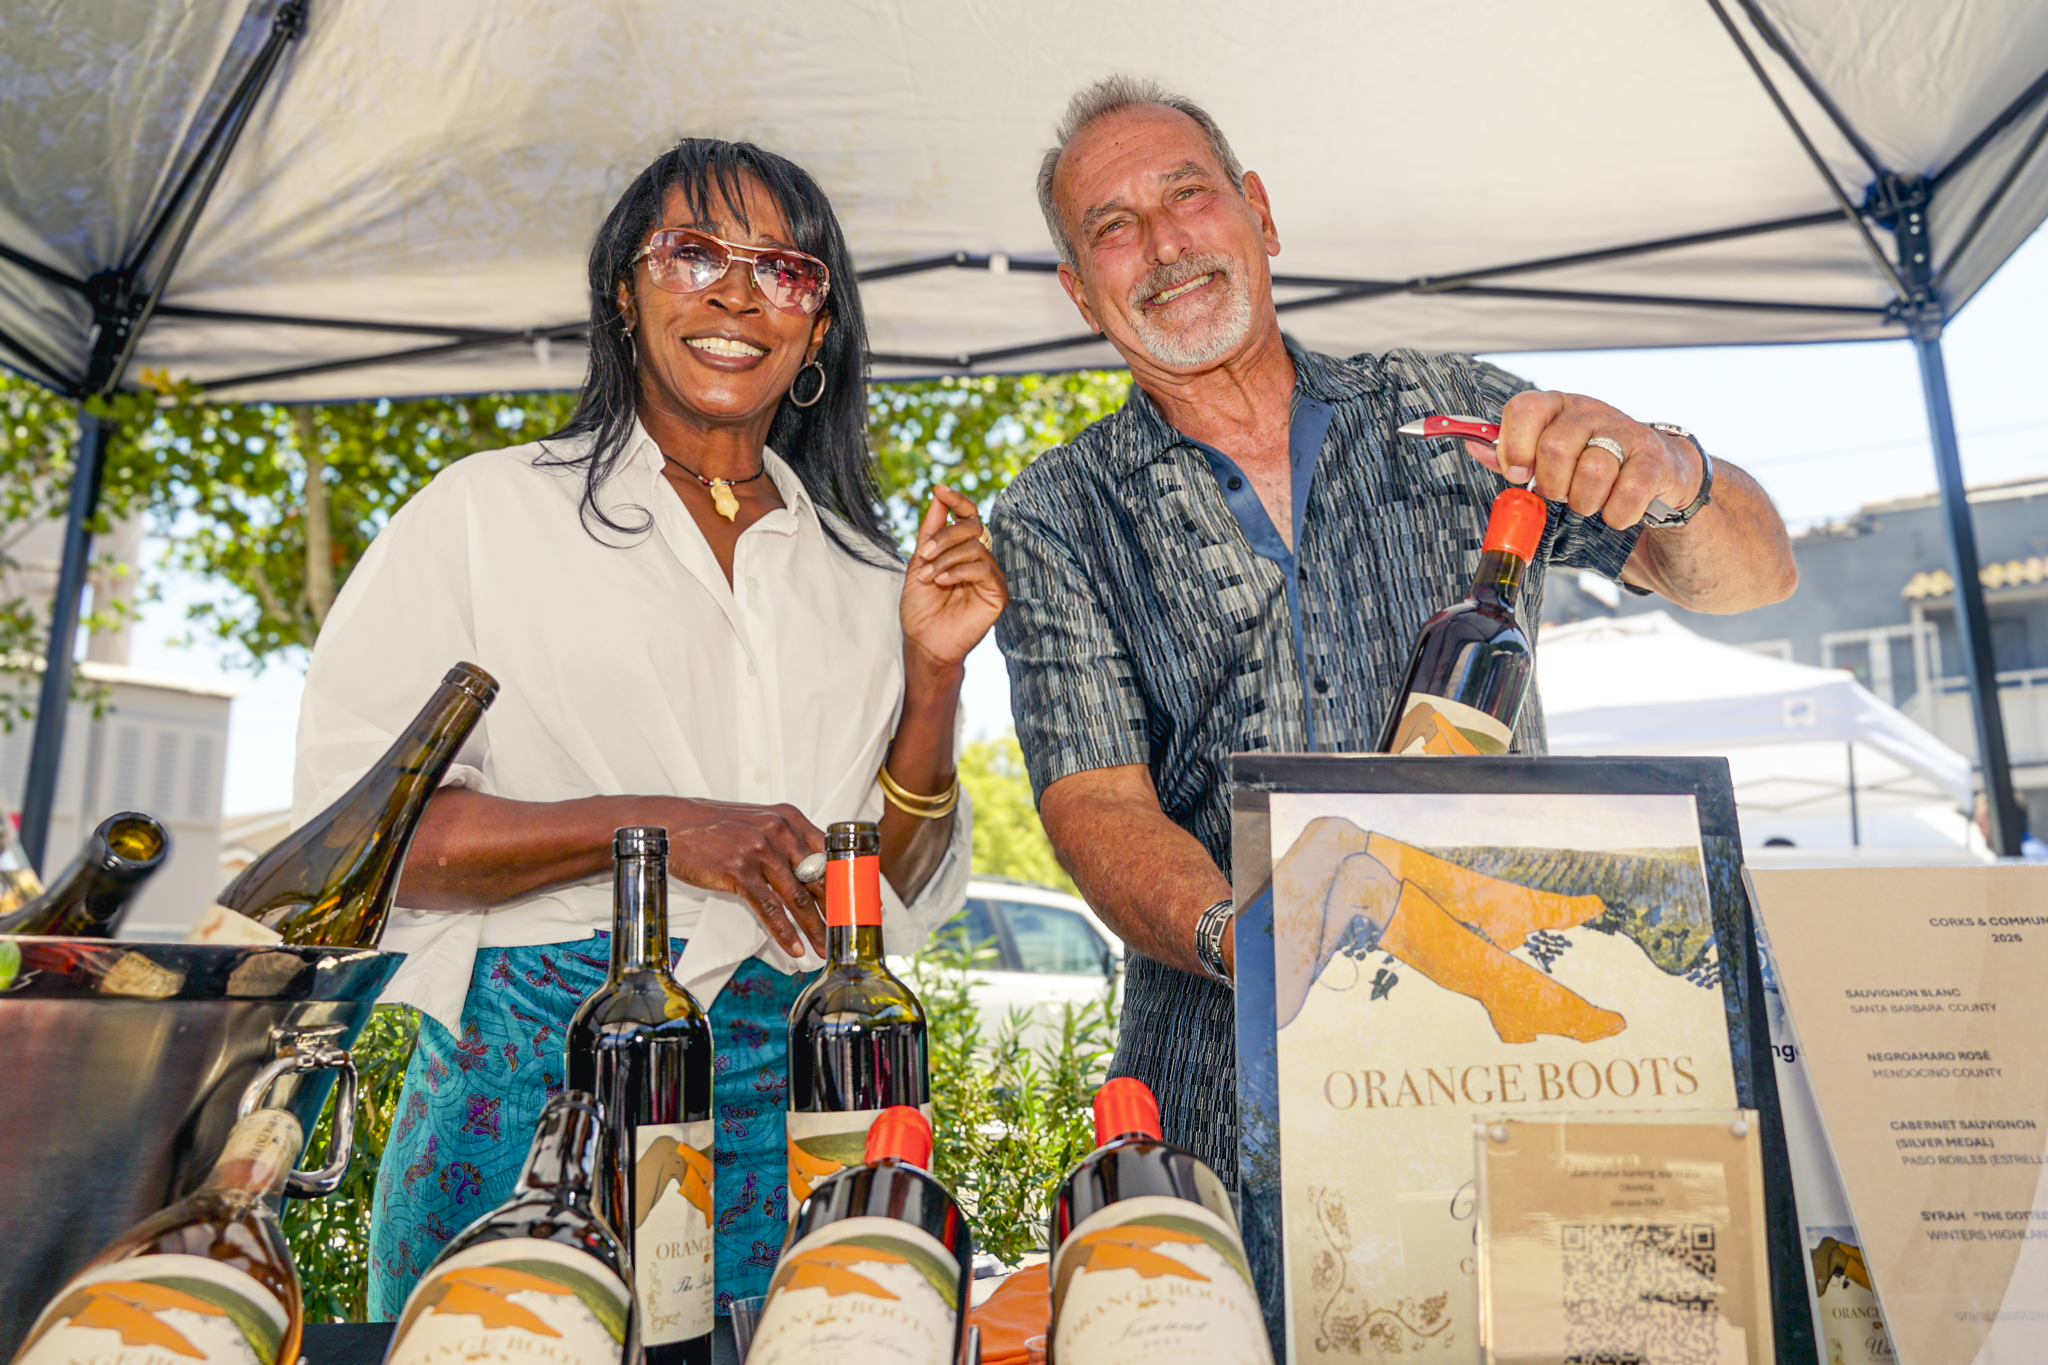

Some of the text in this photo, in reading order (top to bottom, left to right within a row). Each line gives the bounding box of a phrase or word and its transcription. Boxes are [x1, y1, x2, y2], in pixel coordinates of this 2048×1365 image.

[1929, 916, 2048, 927] CORKS & COMMUN
[1991, 933, 2022, 943] 2026
[1845, 988, 1961, 998] SAUVIGNON BLANC
[1850, 1003, 1997, 1013] SANTA BARBARA COUNTY
[1866, 1049, 1992, 1061] NEGROAMARO ROSÉ
[1872, 1067, 2002, 1078] MENDOCINO COUNTY
[1323, 1055, 1699, 1110] ORANGE BOOTS
[1890, 1119, 2036, 1130] CABERNET SAUVIGNON
[1895, 1137, 1995, 1149] (SILVER MEDAL)
[1901, 1155, 1935, 1166] PASO
[1937, 1154, 1987, 1165] ROBLES
[1920, 1210, 1966, 1221] SYRAH
[1926, 1229, 2048, 1240] WINTERS HIGHLAN
